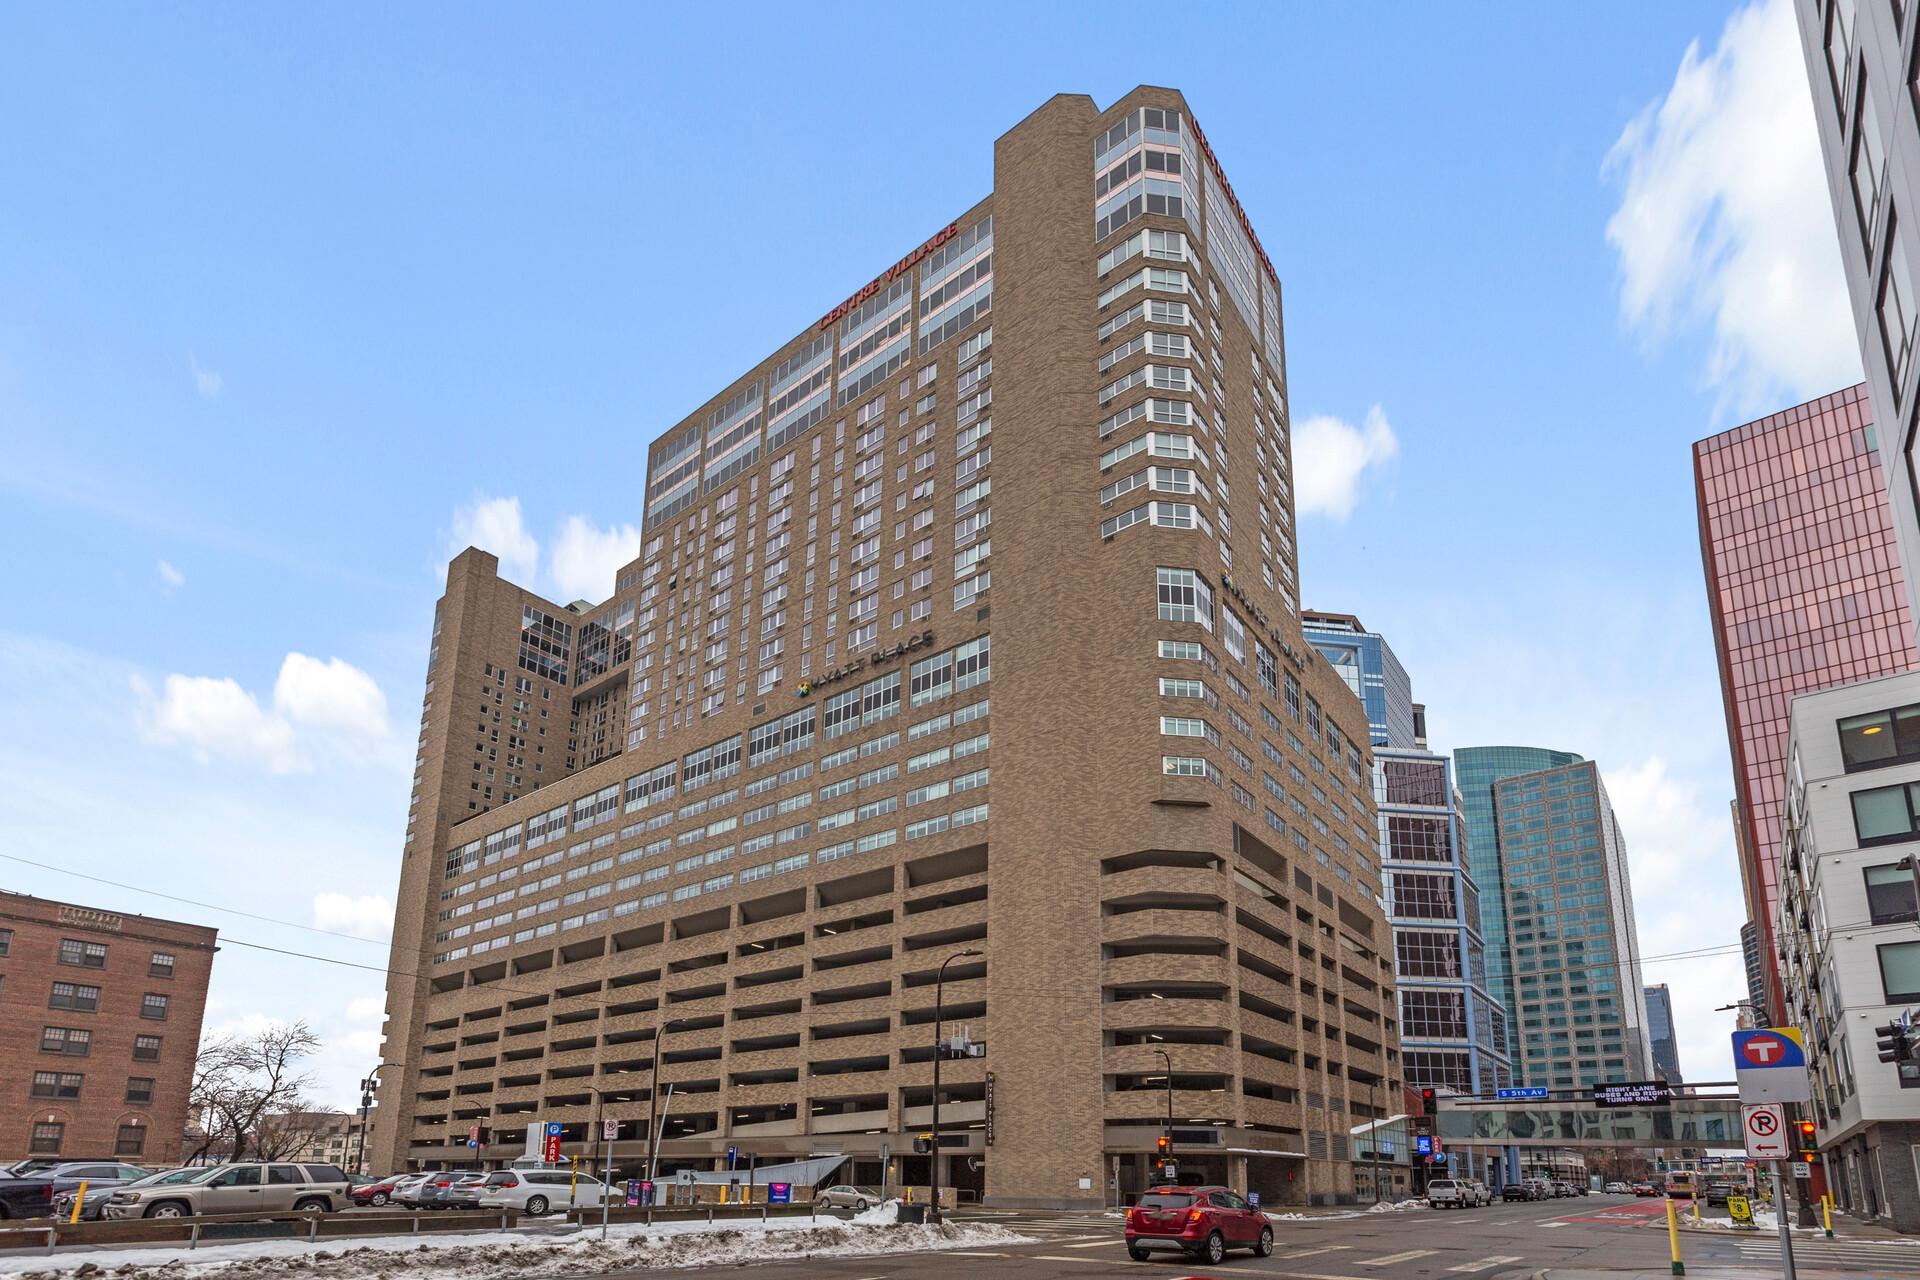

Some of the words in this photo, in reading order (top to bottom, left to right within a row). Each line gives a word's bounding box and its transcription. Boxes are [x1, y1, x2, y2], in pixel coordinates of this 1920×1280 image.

[817, 278, 881, 330] CENTRE
[885, 221, 958, 282] VILLAGE
[810, 657, 865, 690] HYATT
[1511, 1089, 1527, 1097] 5th
